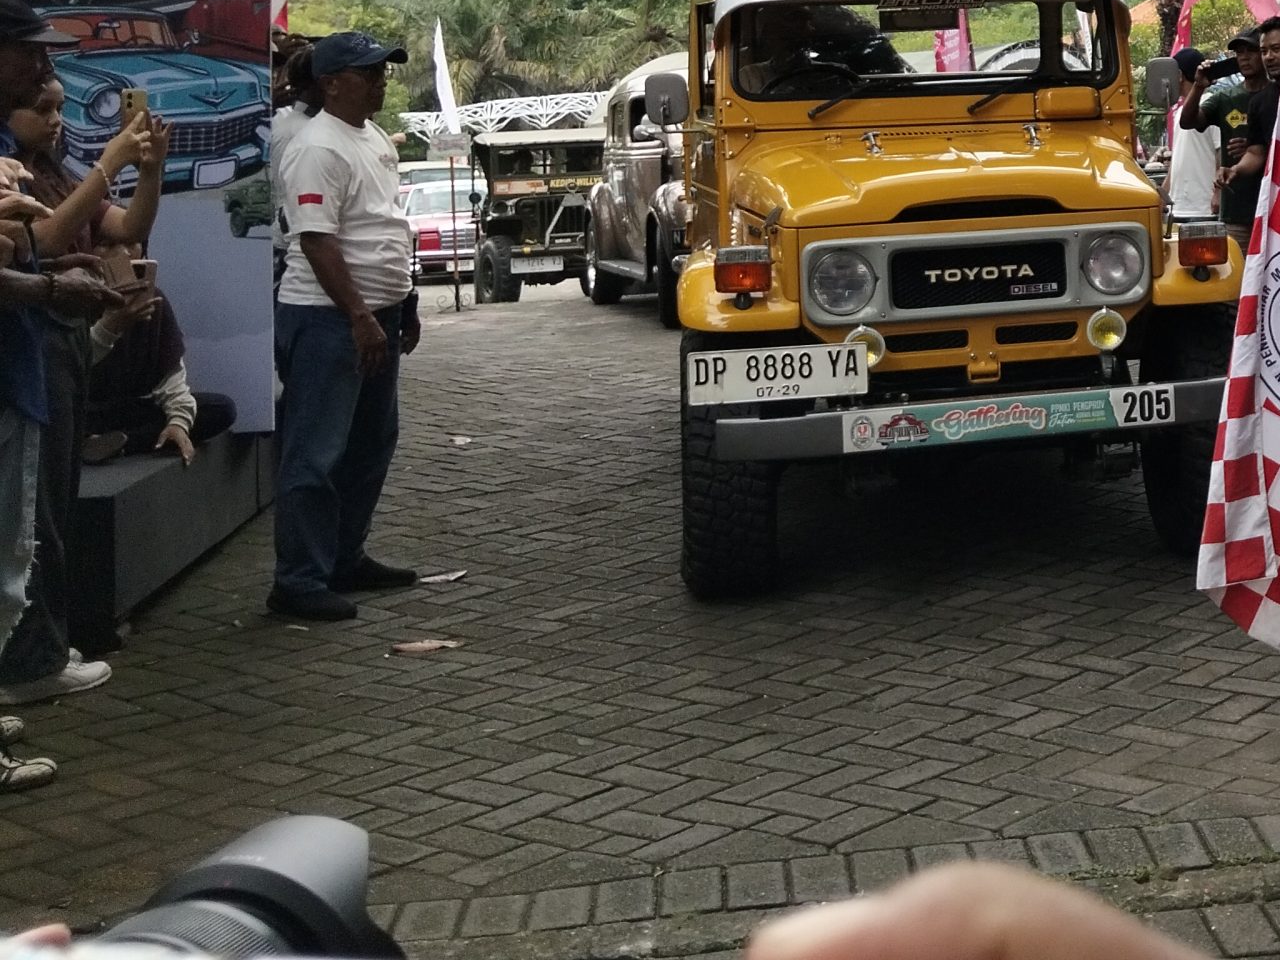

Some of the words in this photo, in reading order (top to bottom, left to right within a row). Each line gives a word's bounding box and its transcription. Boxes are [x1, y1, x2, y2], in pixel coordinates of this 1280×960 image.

[925, 264, 1034, 283] TOYOTA
[1011, 283, 1058, 294] DIESEL
[694, 357, 727, 386] DP
[746, 352, 813, 382] 8888
[827, 349, 859, 378] YA
[931, 402, 1047, 439] Gathering
[1122, 388, 1171, 424] 205
